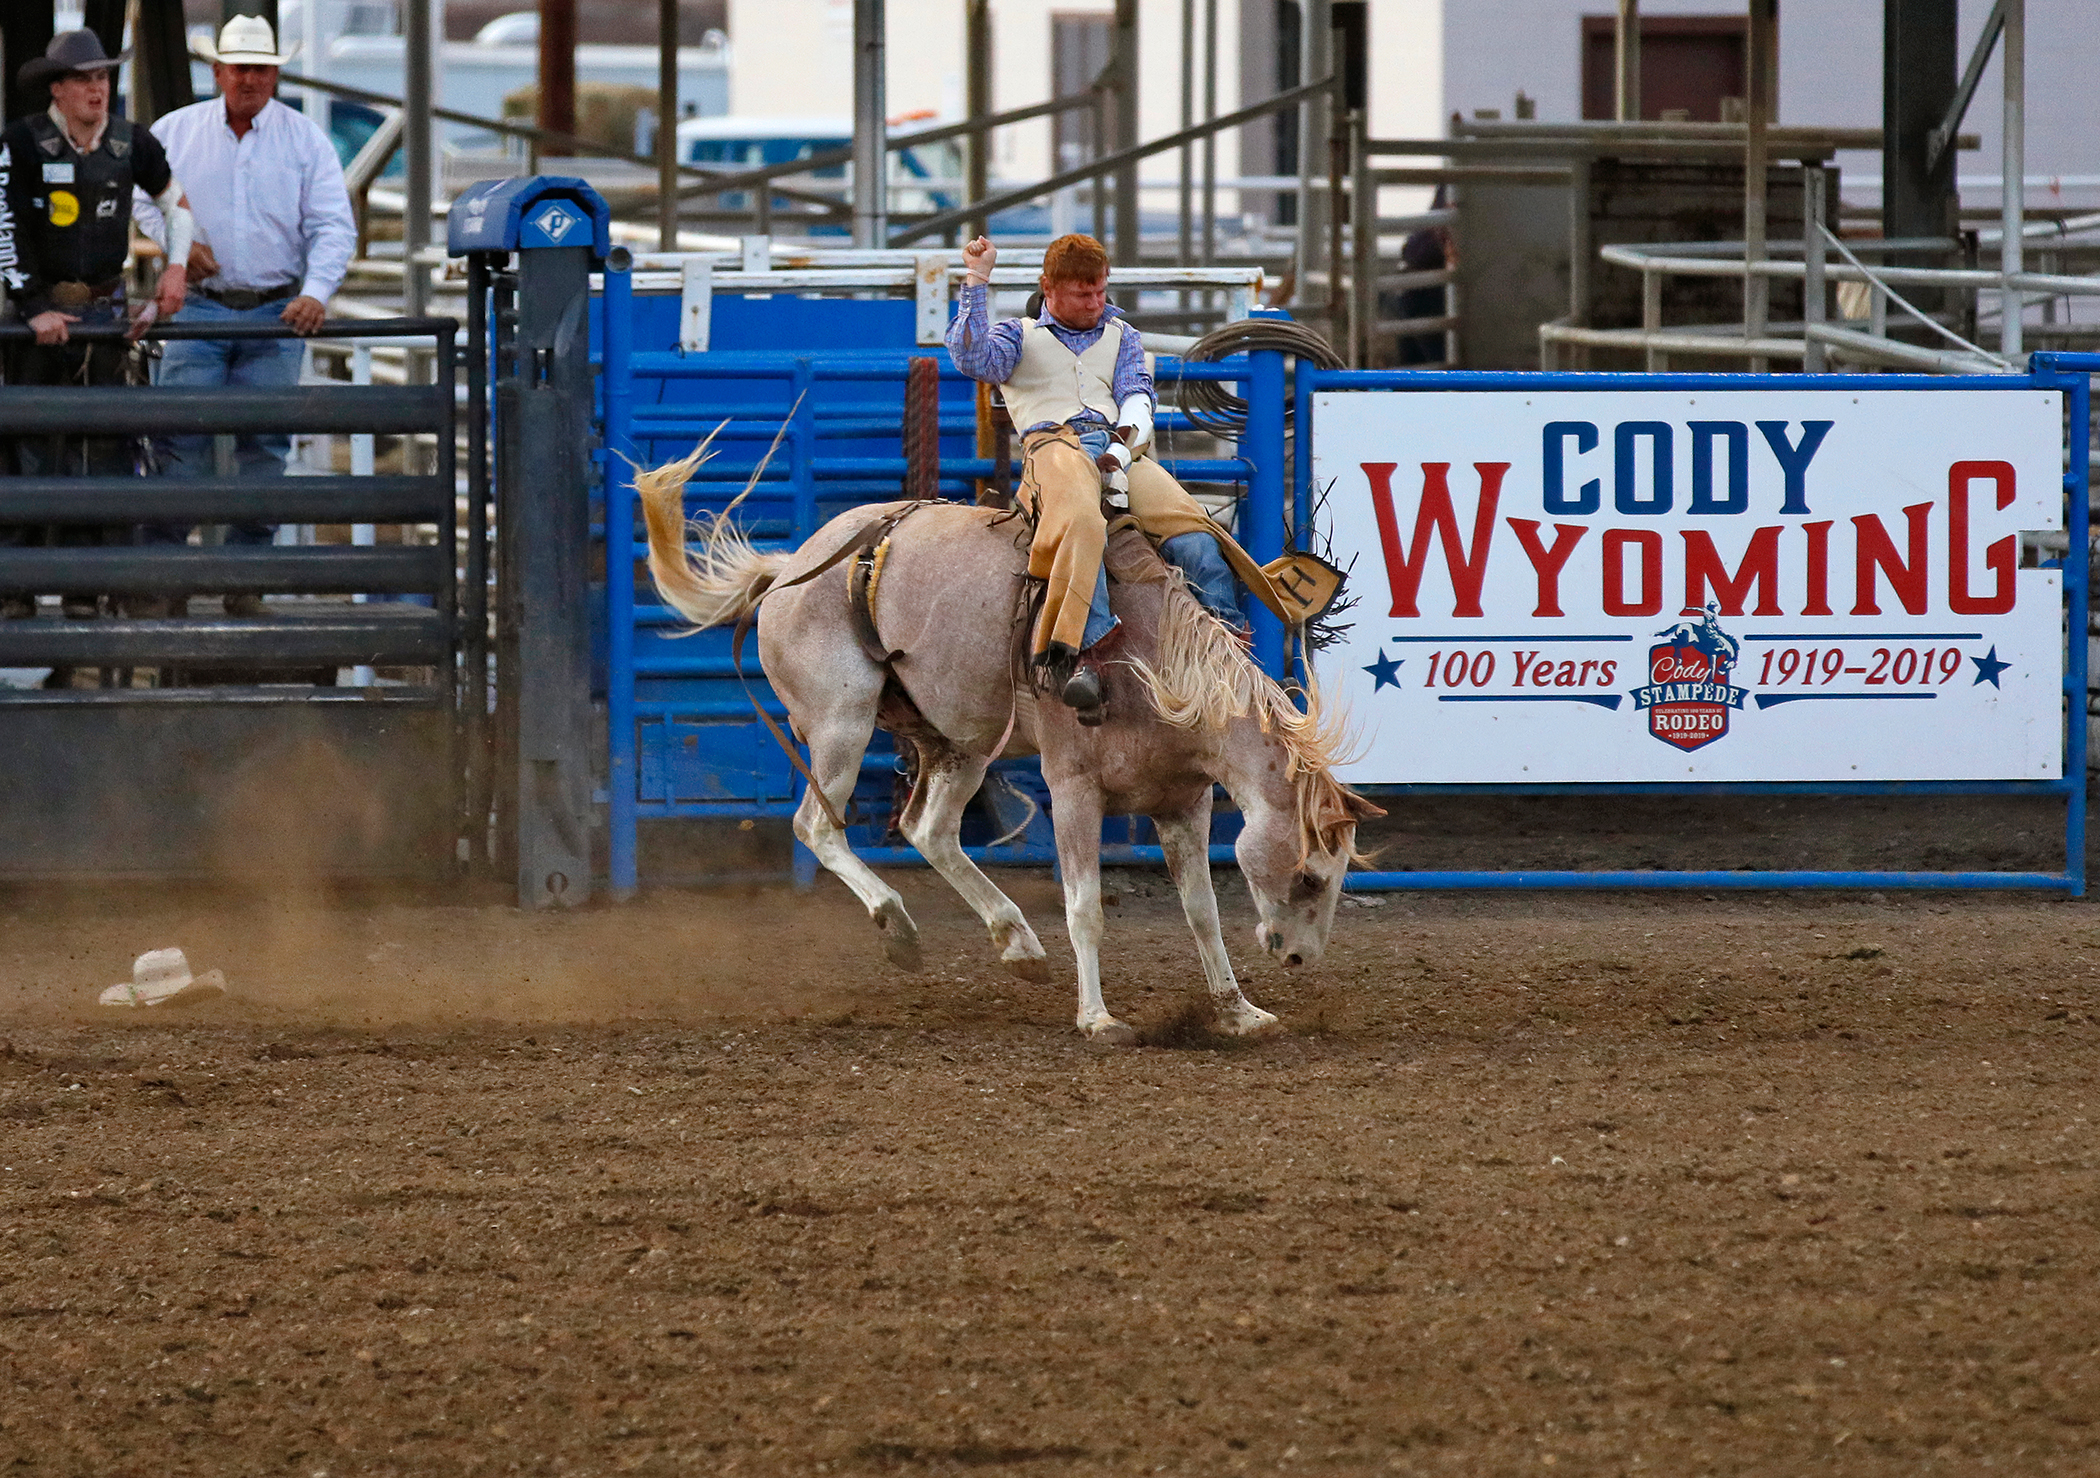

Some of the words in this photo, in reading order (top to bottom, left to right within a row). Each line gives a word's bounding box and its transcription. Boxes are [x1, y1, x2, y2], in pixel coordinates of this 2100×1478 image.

[1542, 420, 1834, 516] CODY
[1361, 460, 2016, 618] WYOMING
[1424, 650, 1496, 688] 100
[1512, 651, 1618, 687] Years
[1651, 656, 1711, 685] Cody
[1639, 683, 1740, 706] STAMPEDE
[1655, 714, 1724, 731] RODEO
